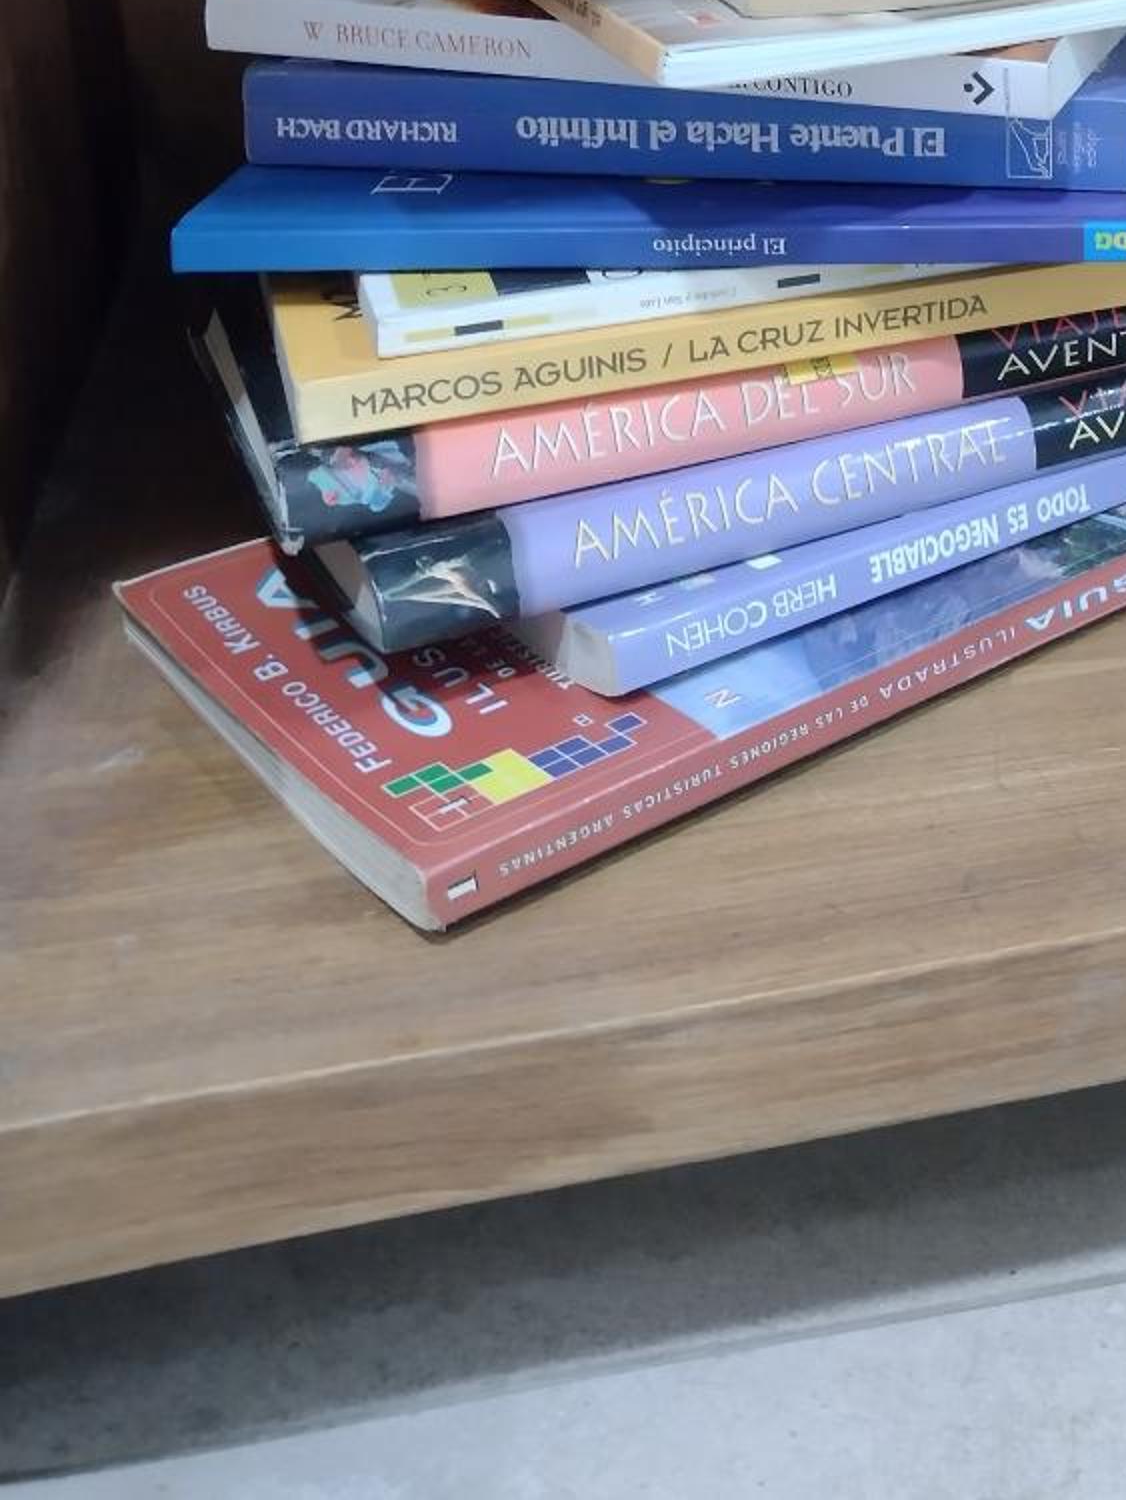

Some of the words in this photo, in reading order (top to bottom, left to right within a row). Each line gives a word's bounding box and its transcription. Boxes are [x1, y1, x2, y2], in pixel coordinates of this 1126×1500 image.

[335, 23, 408, 47] BRUCE
[415, 26, 532, 60] CAMERON
[276, 116, 341, 141] BACH
[346, 119, 458, 144] RICHARD
[516, 115, 639, 150] Infinito
[649, 118, 678, 151] el
[686, 119, 780, 154] Hacia
[790, 123, 909, 158] Puente
[912, 126, 946, 158] El
[652, 233, 756, 257] principito
[763, 238, 786, 256] El
[350, 370, 502, 419] MARCOS
[512, 347, 647, 393] AGUINIS
[689, 335, 730, 364] LA
[737, 318, 825, 355] CRUZ
[835, 293, 988, 340] INVERTIDA
[491, 388, 727, 481] AMÉRICA
[739, 373, 820, 429] DEL
[836, 352, 917, 407] SUR
[575, 472, 800, 569] AMÉRICA
[811, 421, 1008, 506] CENTRAL
[1037, 482, 1091, 524] TODO
[1007, 502, 1029, 534] ES
[869, 513, 999, 584] NEGOCIABLE
[773, 574, 838, 618] HERB
[182, 584, 262, 656] KIRBUS
[665, 600, 768, 657] COHEN
[878, 627, 1016, 700] ILUSTRADA
[815, 709, 843, 731] LAS
[850, 693, 870, 714] DE
[281, 680, 393, 774] FEDERICO
[728, 722, 809, 770] REGIONES
[498, 811, 615, 877] ARGENTINAS
